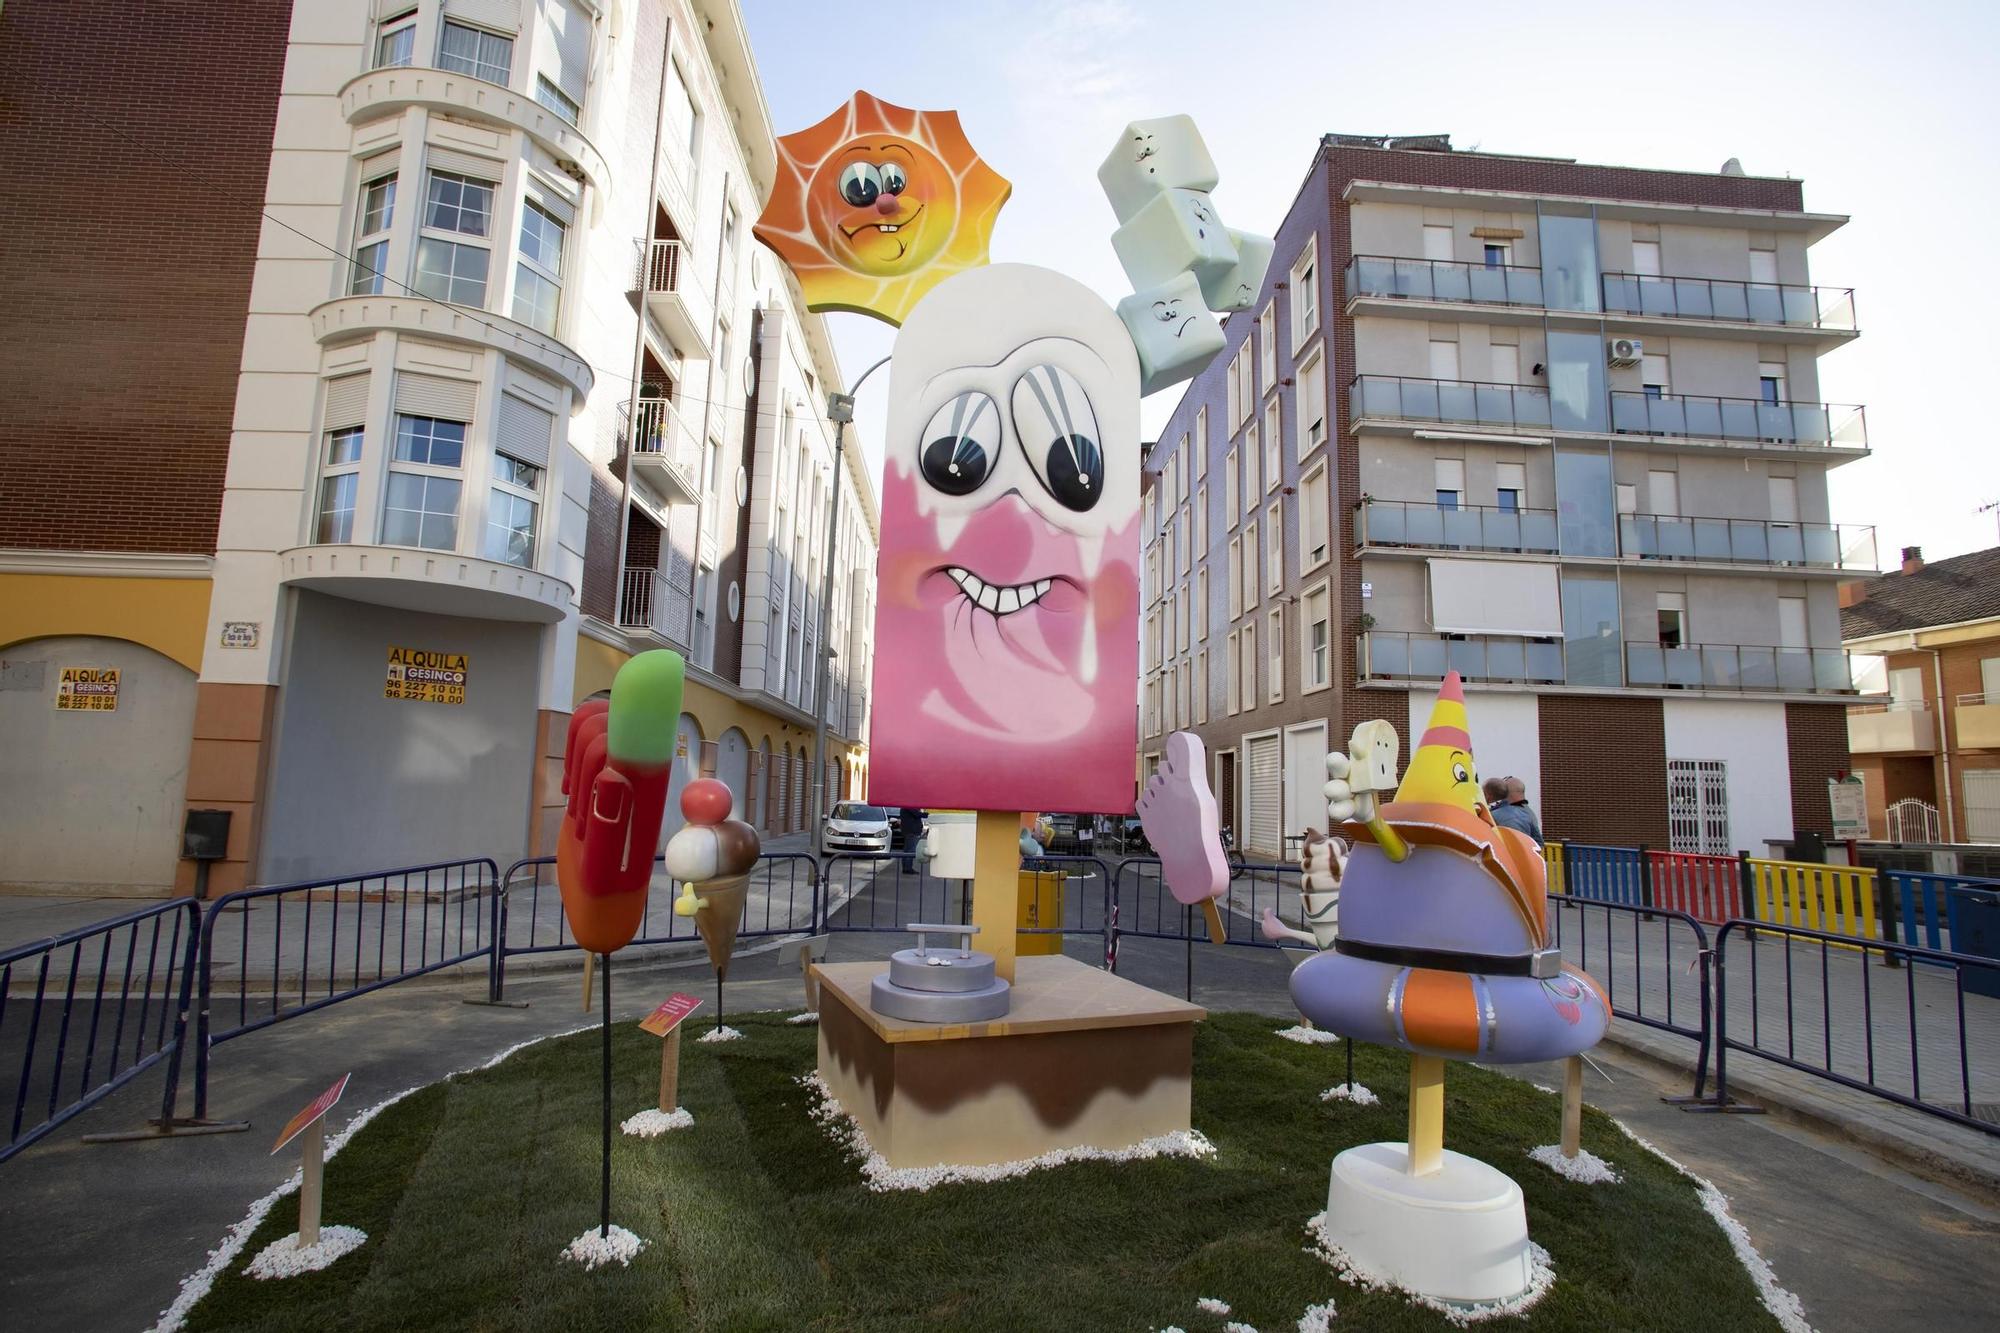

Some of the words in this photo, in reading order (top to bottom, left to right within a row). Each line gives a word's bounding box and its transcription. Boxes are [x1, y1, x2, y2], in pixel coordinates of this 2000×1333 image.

[389, 649, 466, 670] ALQUILA
[408, 668, 463, 683] GESINCO
[77, 684, 116, 692] GESINCO
[387, 680, 401, 688] 96
[405, 681, 427, 691] 227
[431, 685, 445, 693] 10
[449, 686, 462, 695] 01
[386, 689, 400, 698] 96
[404, 690, 426, 700] 227
[430, 694, 444, 703] 10
[448, 695, 462, 704] 00
